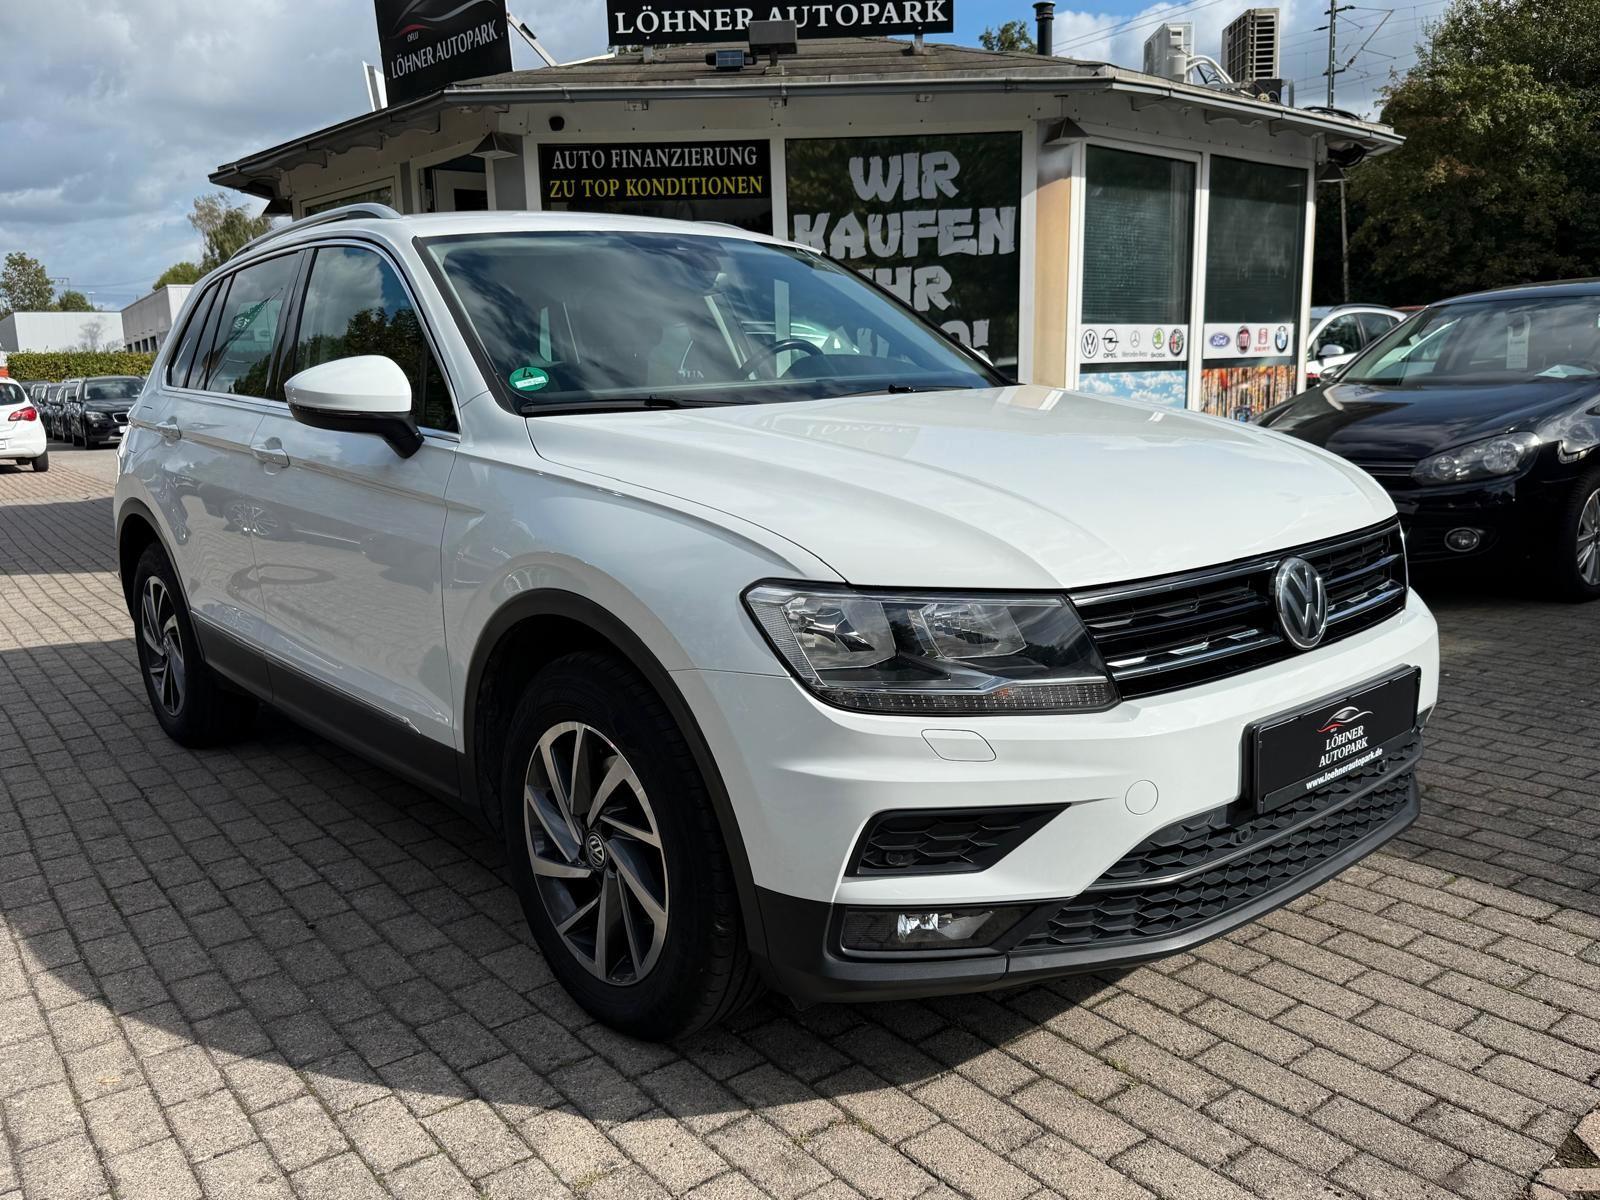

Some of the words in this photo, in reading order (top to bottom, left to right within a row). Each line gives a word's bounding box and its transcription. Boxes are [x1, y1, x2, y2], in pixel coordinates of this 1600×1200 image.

[614, 5, 753, 34] LÖHNER
[391, 46, 435, 79] LÖHNER
[436, 19, 498, 62] AUTOPARK
[552, 151, 605, 169] AUTO
[611, 147, 758, 168] FINANZIERUNG
[550, 180, 575, 198] ZU
[581, 179, 620, 197] TOP
[625, 176, 763, 197] KONDITIONEN
[849, 151, 960, 202] WIR
[793, 206, 1016, 259] KAUFEN
[858, 265, 952, 311] HR
[523, 367, 534, 378] 4
[1319, 736, 1368, 768] AUTOPARK
[1326, 725, 1364, 751] LÖHNER
[1306, 747, 1383, 790] www.loehnerautopark.de
